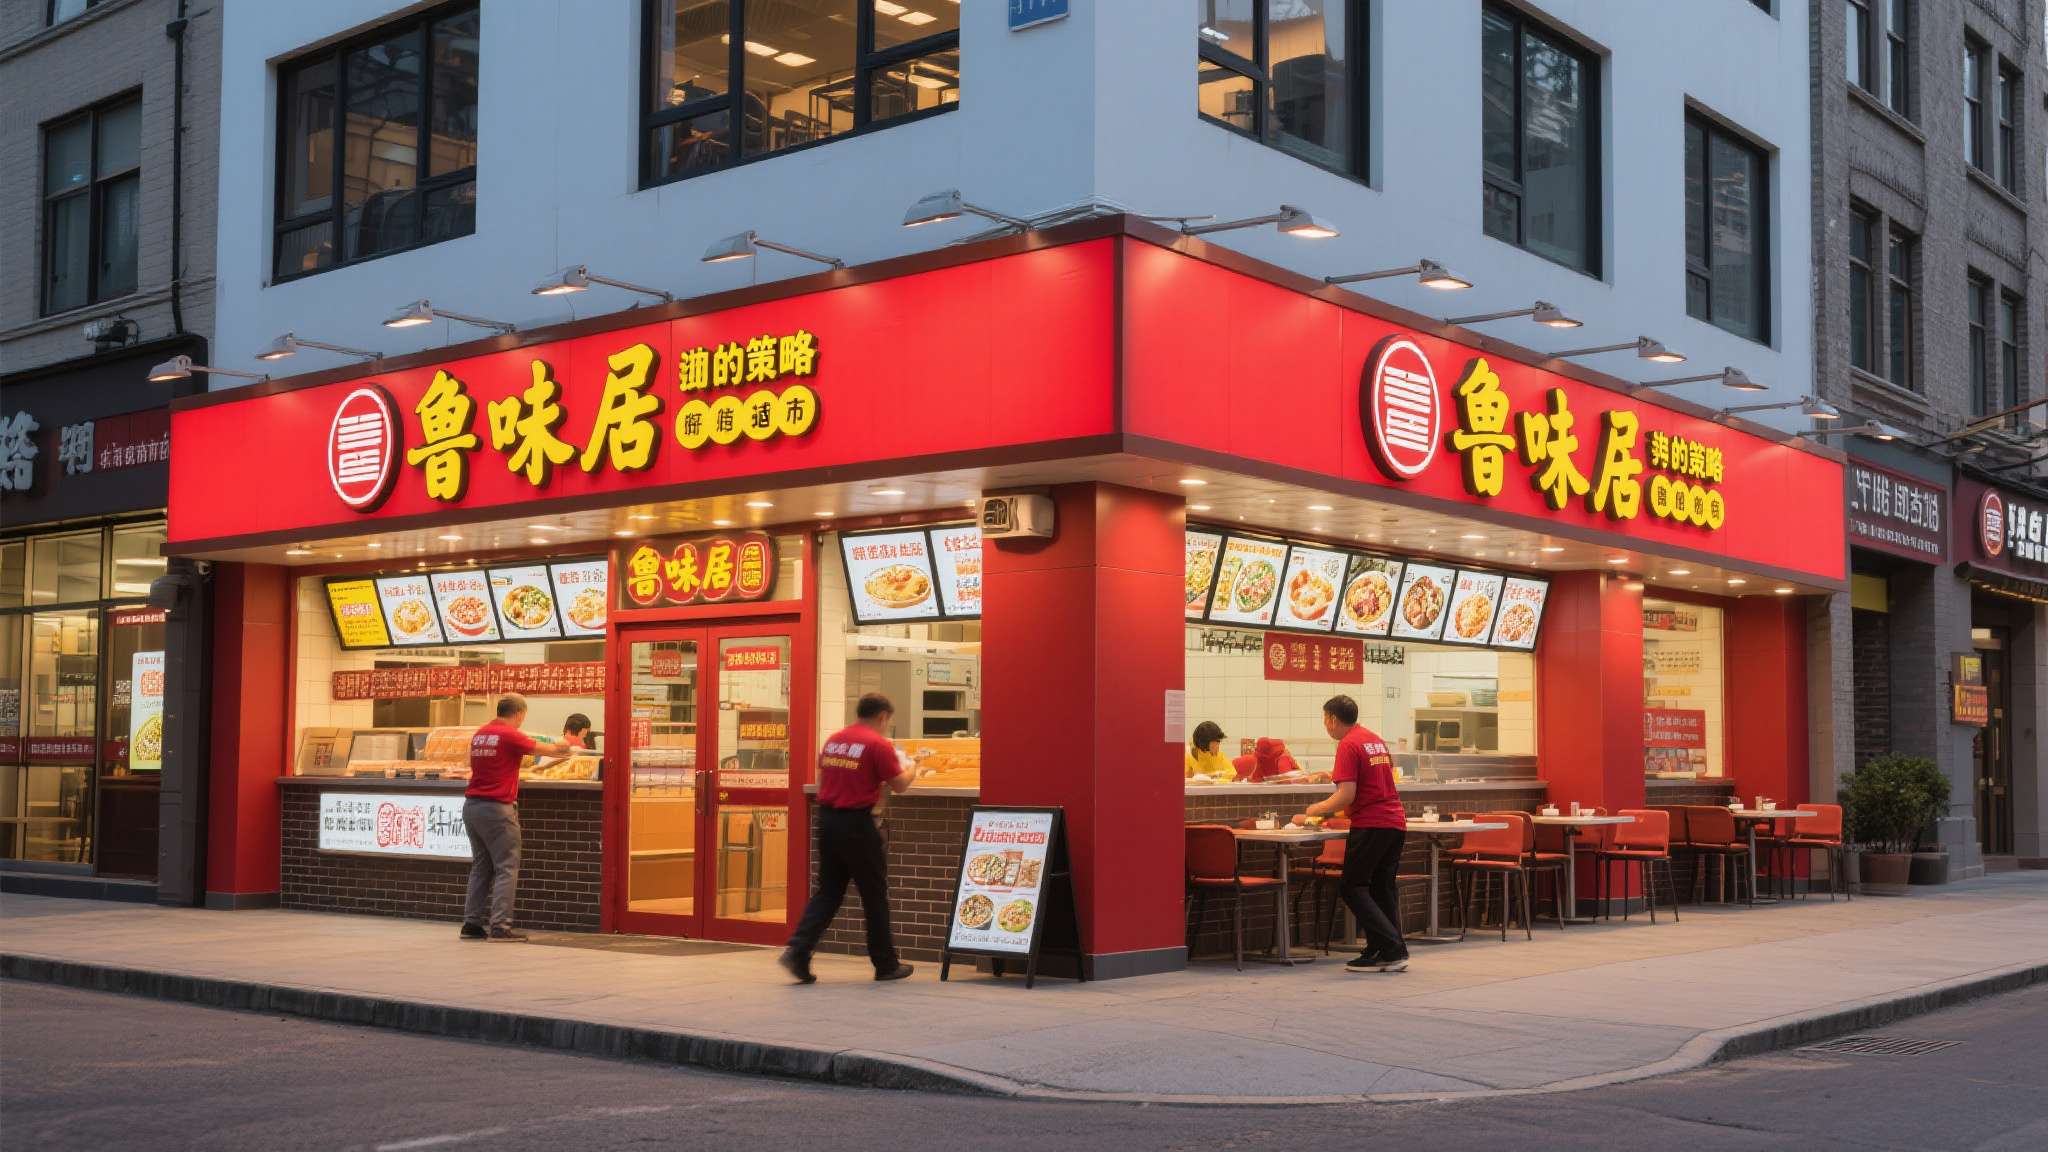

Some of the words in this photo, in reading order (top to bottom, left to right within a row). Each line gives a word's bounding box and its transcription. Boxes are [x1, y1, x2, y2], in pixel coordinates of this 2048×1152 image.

[406, 343, 662, 500] 鲁味居
[1453, 357, 1643, 519] 鲁味居
[629, 544, 734, 597] 鲁味居
